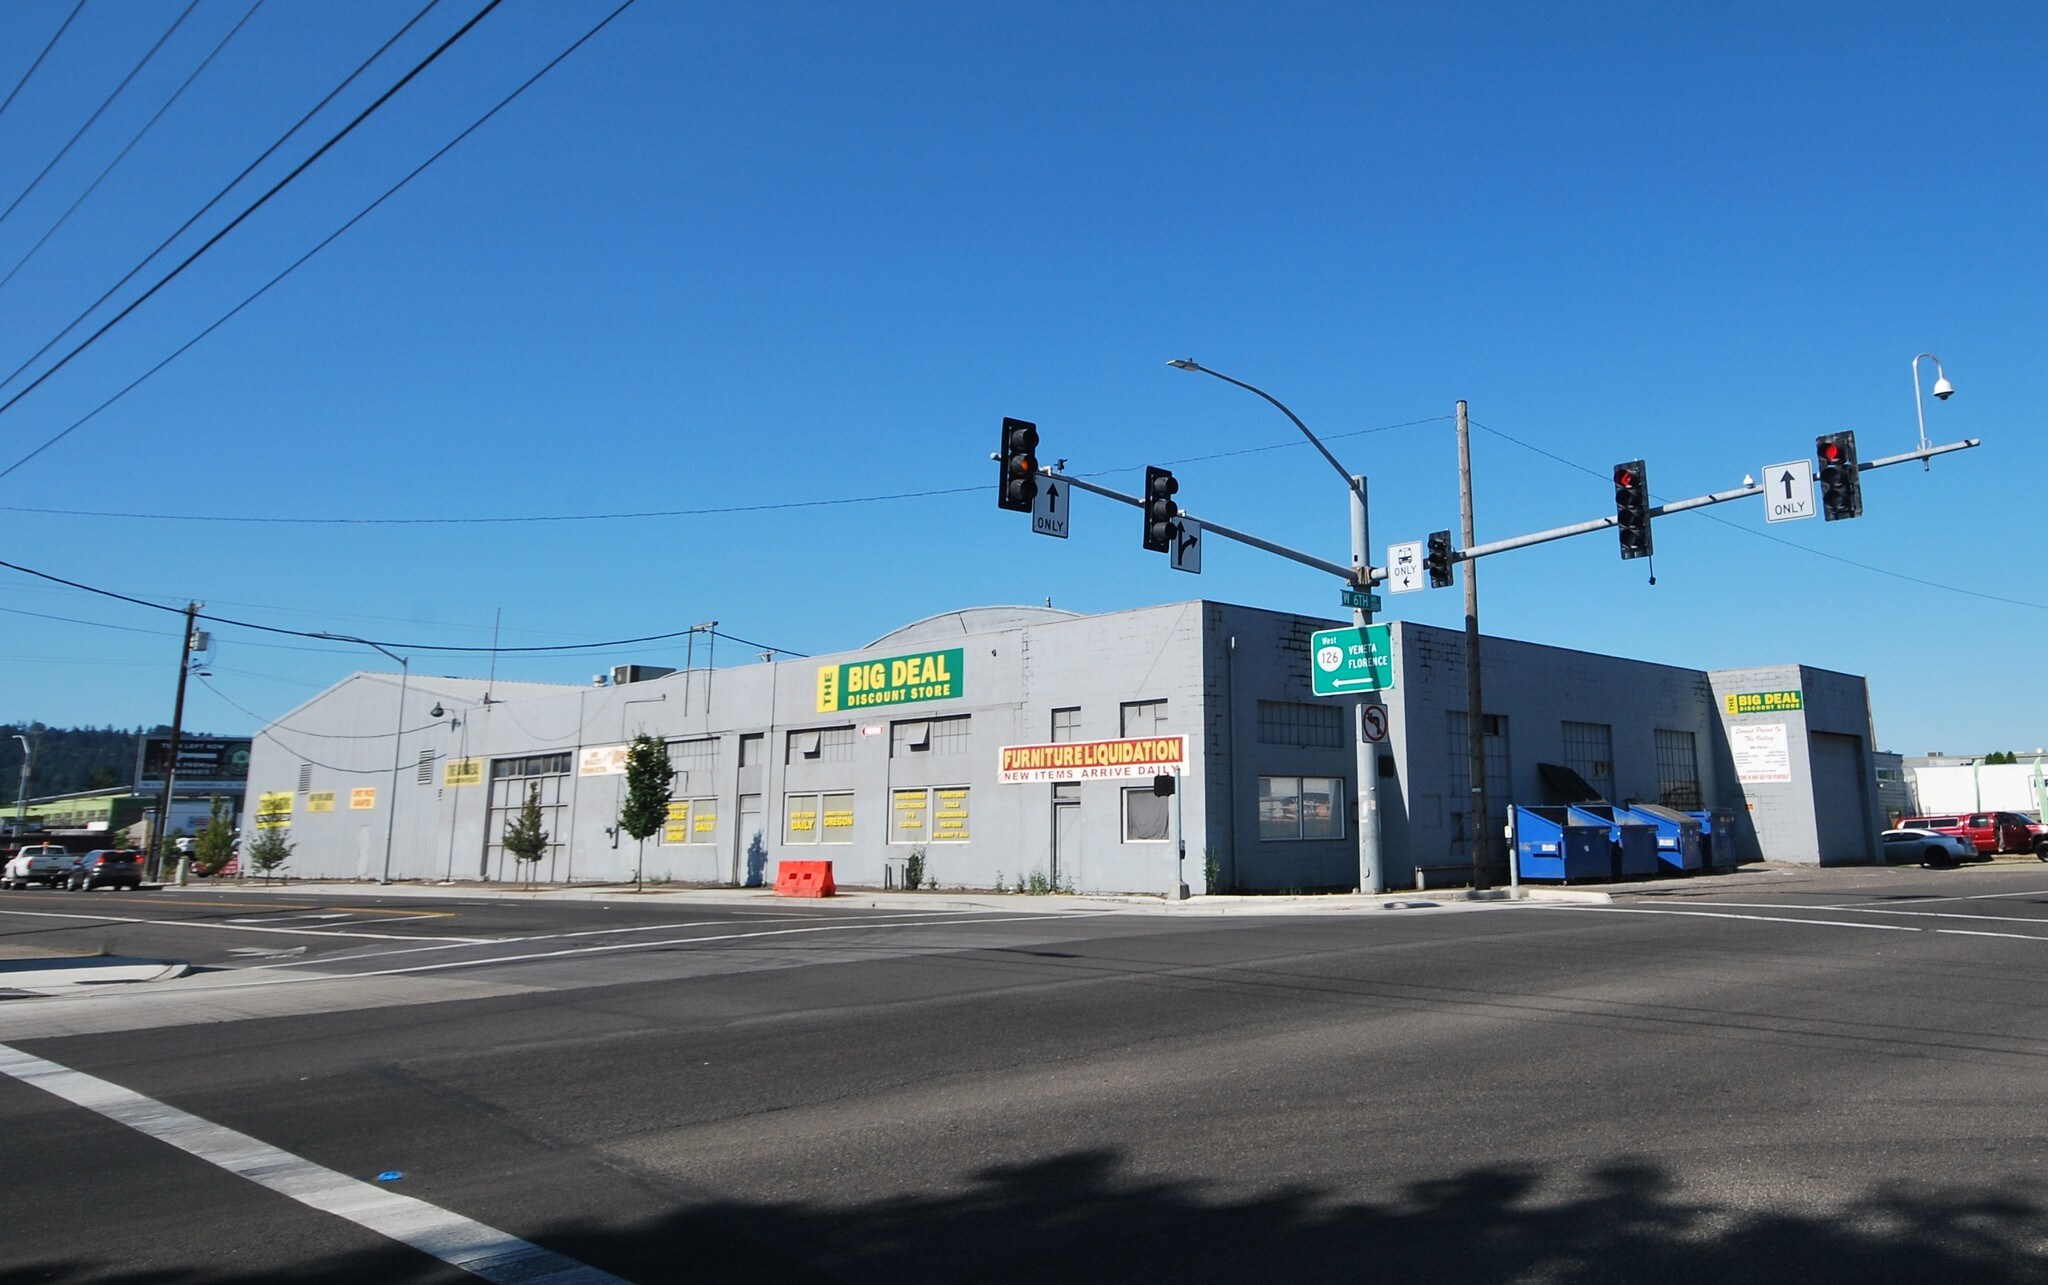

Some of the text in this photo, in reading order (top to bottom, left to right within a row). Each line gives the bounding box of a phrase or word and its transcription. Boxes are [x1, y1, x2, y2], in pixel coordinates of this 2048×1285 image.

[1774, 501, 1805, 516] ONLY
[1037, 516, 1064, 532] ONLY
[1394, 564, 1417, 577] ONLY
[1343, 592, 1350, 604] W
[1353, 594, 1369, 607] 6TH
[1321, 636, 1337, 645] West
[1348, 643, 1377, 655] VENETA
[1322, 652, 1339, 664] 126
[1348, 656, 1388, 669] FLORENCE
[848, 654, 951, 693] BIG DEAL
[823, 672, 833, 706] THE
[847, 684, 950, 706] DISCOUNT STORE
[1727, 696, 1735, 711] THE
[1738, 692, 1800, 706] BIG DEAL
[1739, 704, 1774, 712] DISCOUNT
[1004, 740, 1180, 769] FURNITURE LIQUIDATION
[1004, 765, 1180, 781] NEW ITEMS ARRIVE DAILY
[792, 820, 815, 831] DAILY
[824, 817, 854, 827] OREGON
